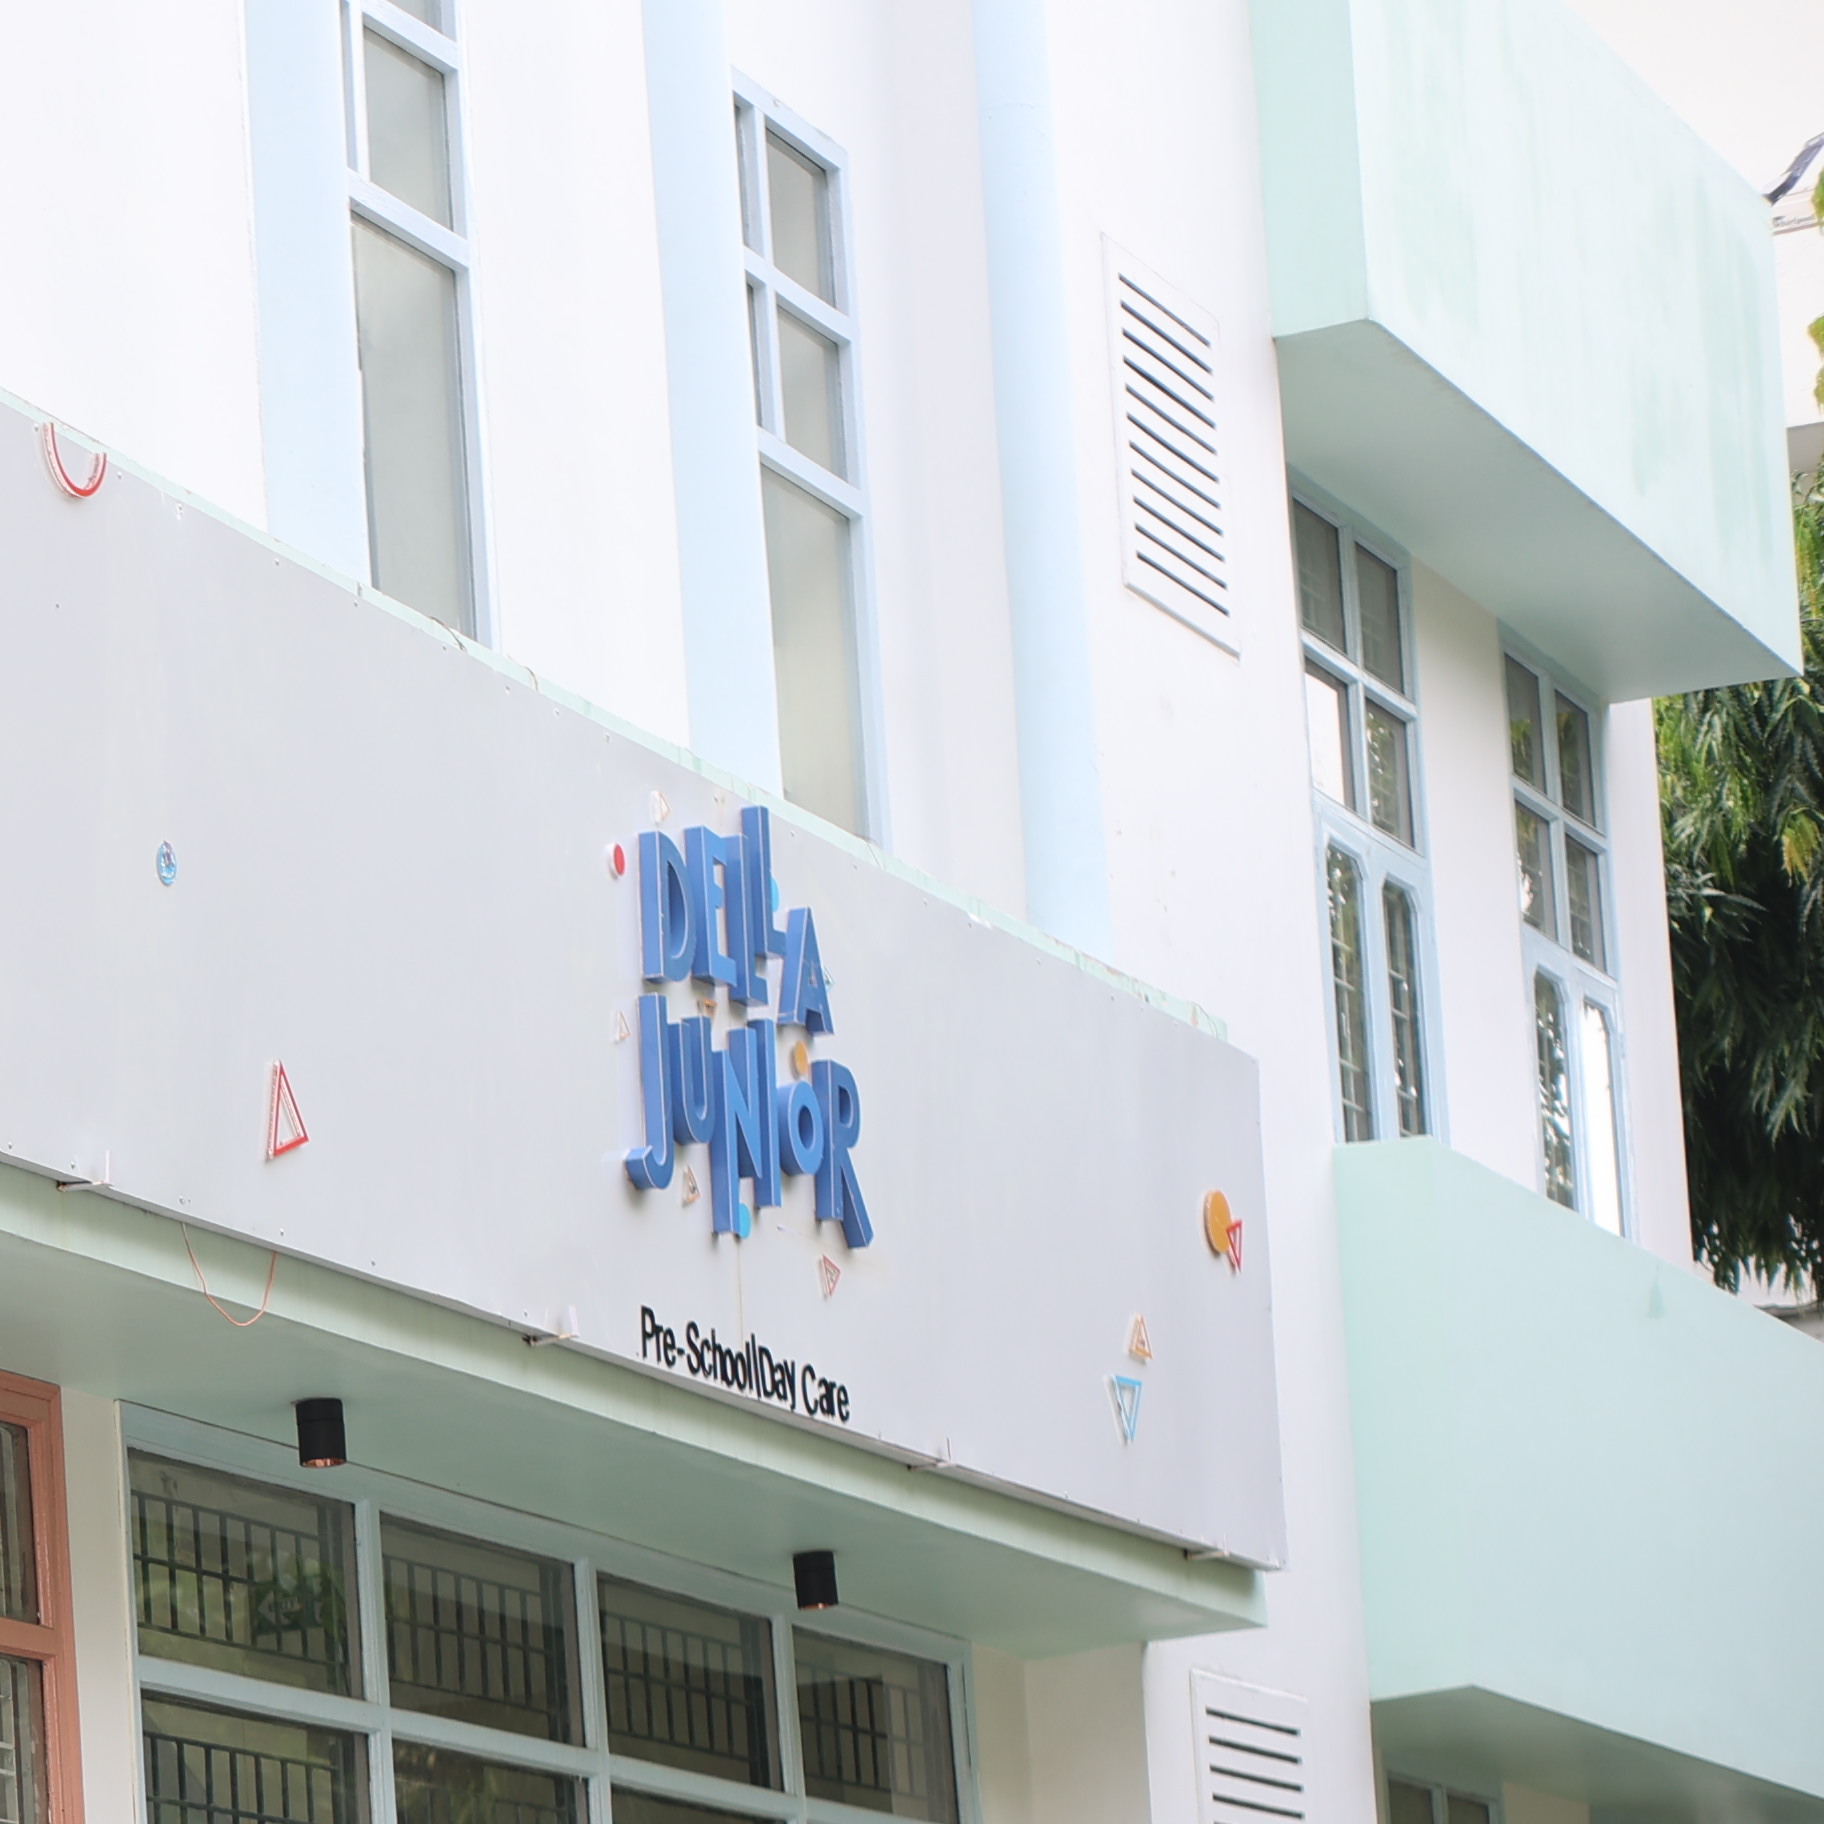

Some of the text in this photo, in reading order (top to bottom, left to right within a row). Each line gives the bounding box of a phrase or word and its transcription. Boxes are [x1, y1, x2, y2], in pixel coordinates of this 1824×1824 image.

[638, 806, 834, 1035] DELLA
[626, 992, 873, 1248] JUNIOR
[802, 1364, 850, 1421] Care
